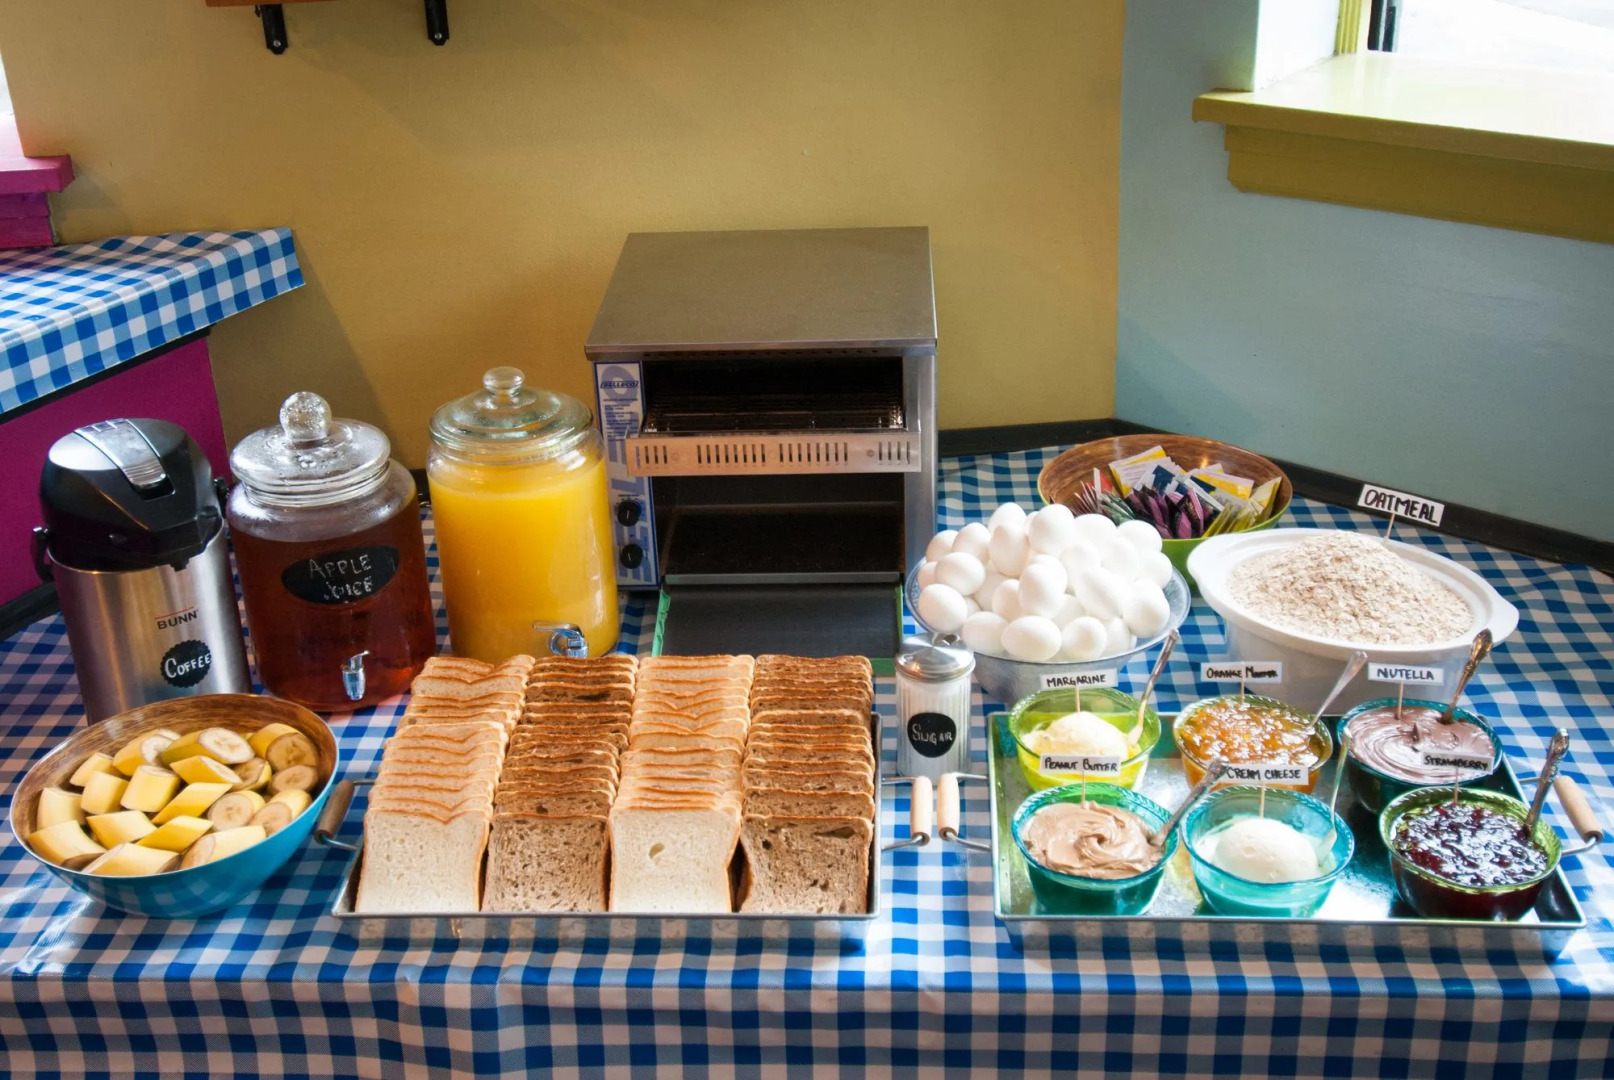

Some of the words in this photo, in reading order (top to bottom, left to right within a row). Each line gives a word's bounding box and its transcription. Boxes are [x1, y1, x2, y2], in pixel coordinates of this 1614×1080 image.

[1364, 489, 1438, 524] OATMEAL
[308, 554, 372, 579] APPLE
[157, 611, 197, 630] BUNN
[165, 653, 211, 678] COFFEE
[1206, 667, 1242, 678] ORANGE
[1046, 674, 1106, 687] MARGARINE
[1377, 668, 1434, 680] NUTELLA
[912, 723, 952, 746] SUGAR
[1044, 757, 1078, 770] PEANUT
[1082, 758, 1118, 772] BUTTER
[1424, 755, 1488, 771] STRAWBERRY
[1226, 766, 1261, 781] CREAM
[1264, 769, 1302, 780] CHEESE
